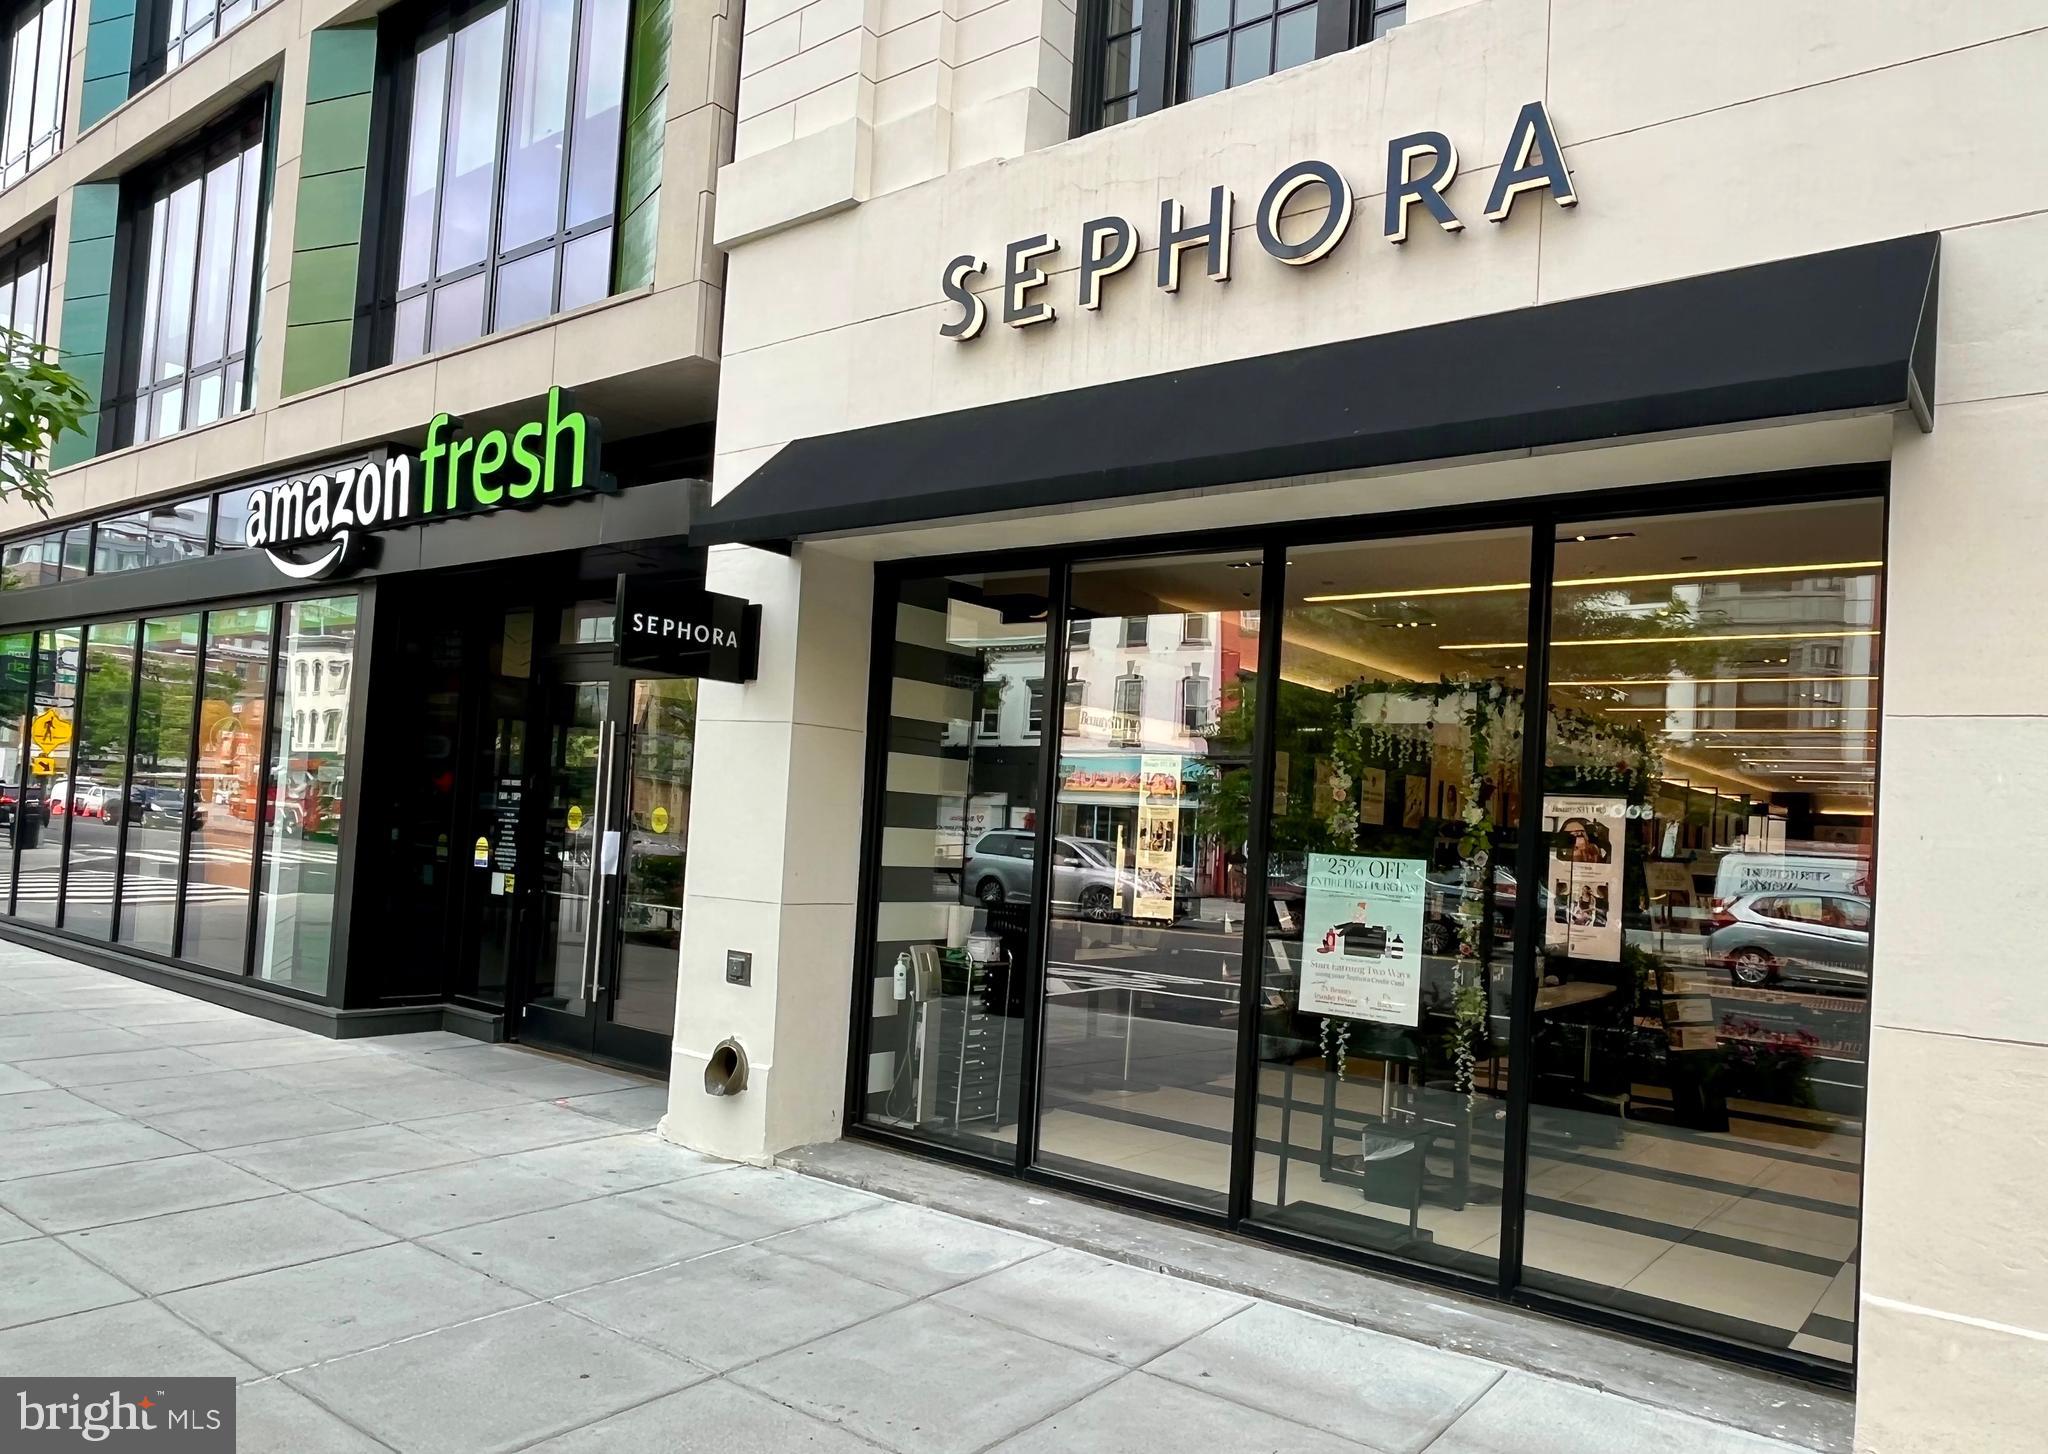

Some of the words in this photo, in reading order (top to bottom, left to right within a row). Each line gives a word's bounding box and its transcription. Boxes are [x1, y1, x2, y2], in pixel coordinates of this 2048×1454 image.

[938, 101, 1579, 342] SEPHORA
[245, 454, 410, 548] amazon
[420, 386, 586, 514] fresh
[632, 613, 738, 649] SEPHORA
[1328, 857, 1364, 876] 25%
[1369, 860, 1408, 879] OFF
